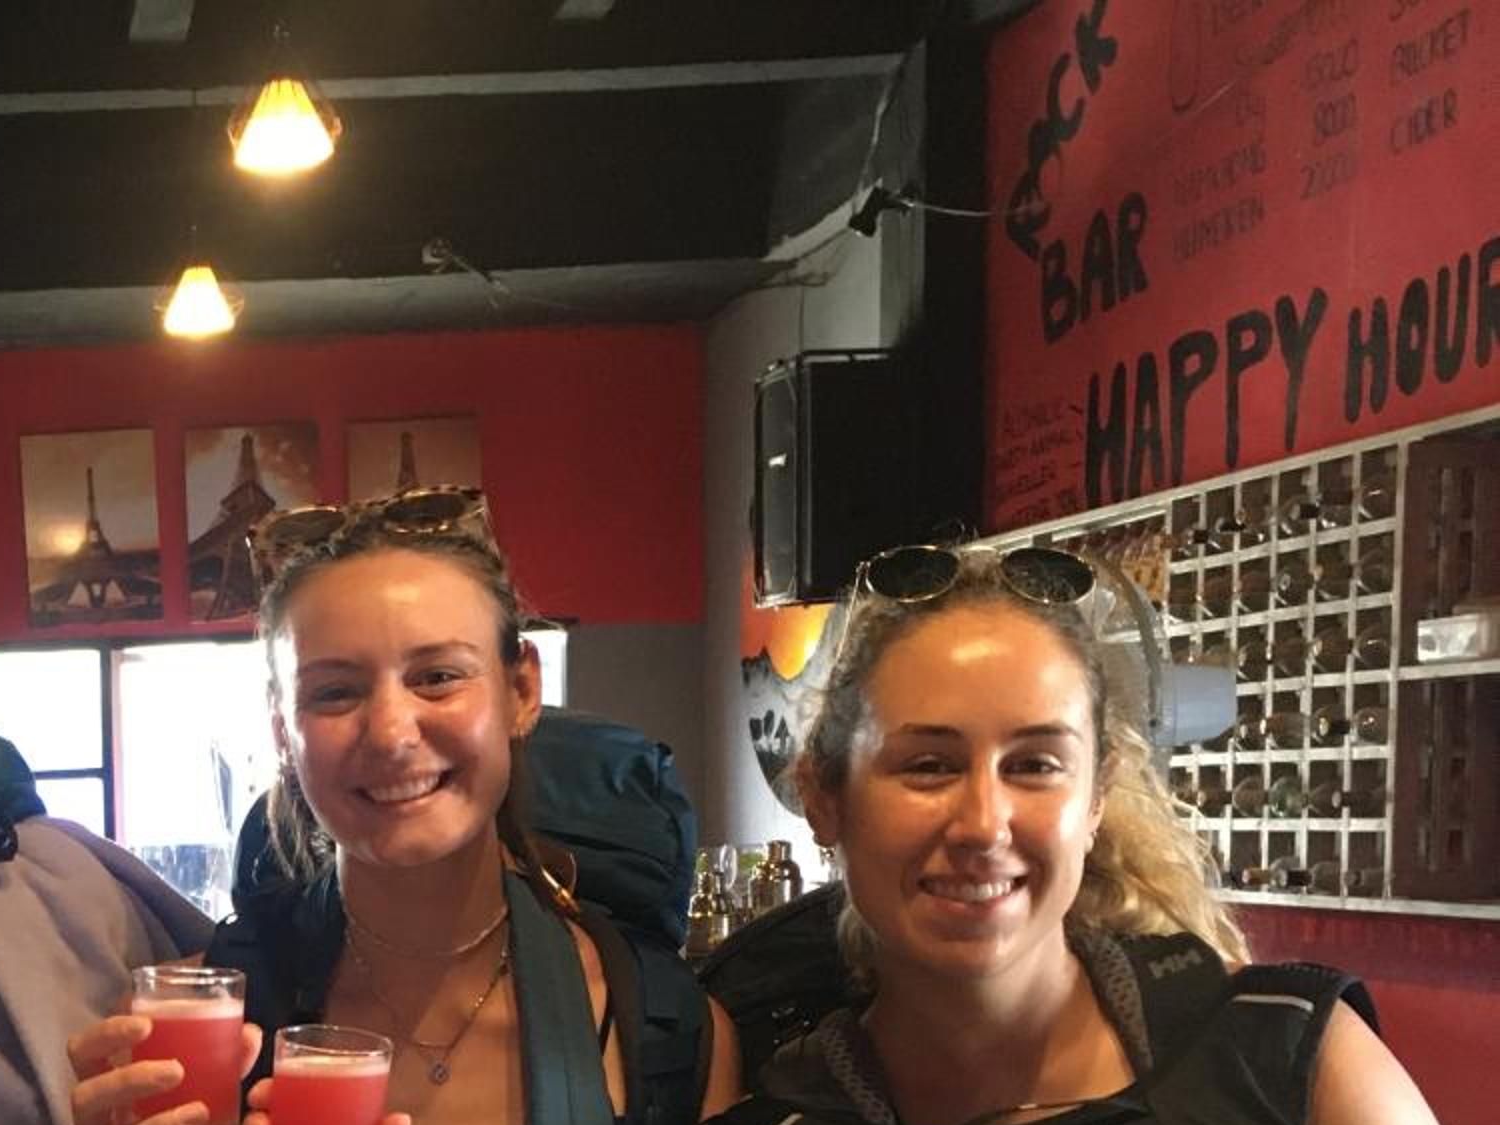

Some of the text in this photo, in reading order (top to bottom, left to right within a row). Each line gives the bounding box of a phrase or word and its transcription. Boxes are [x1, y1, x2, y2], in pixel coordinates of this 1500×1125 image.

[1041, 191, 1149, 345] BAR
[1085, 236, 1500, 510] HAPPY HOUR
